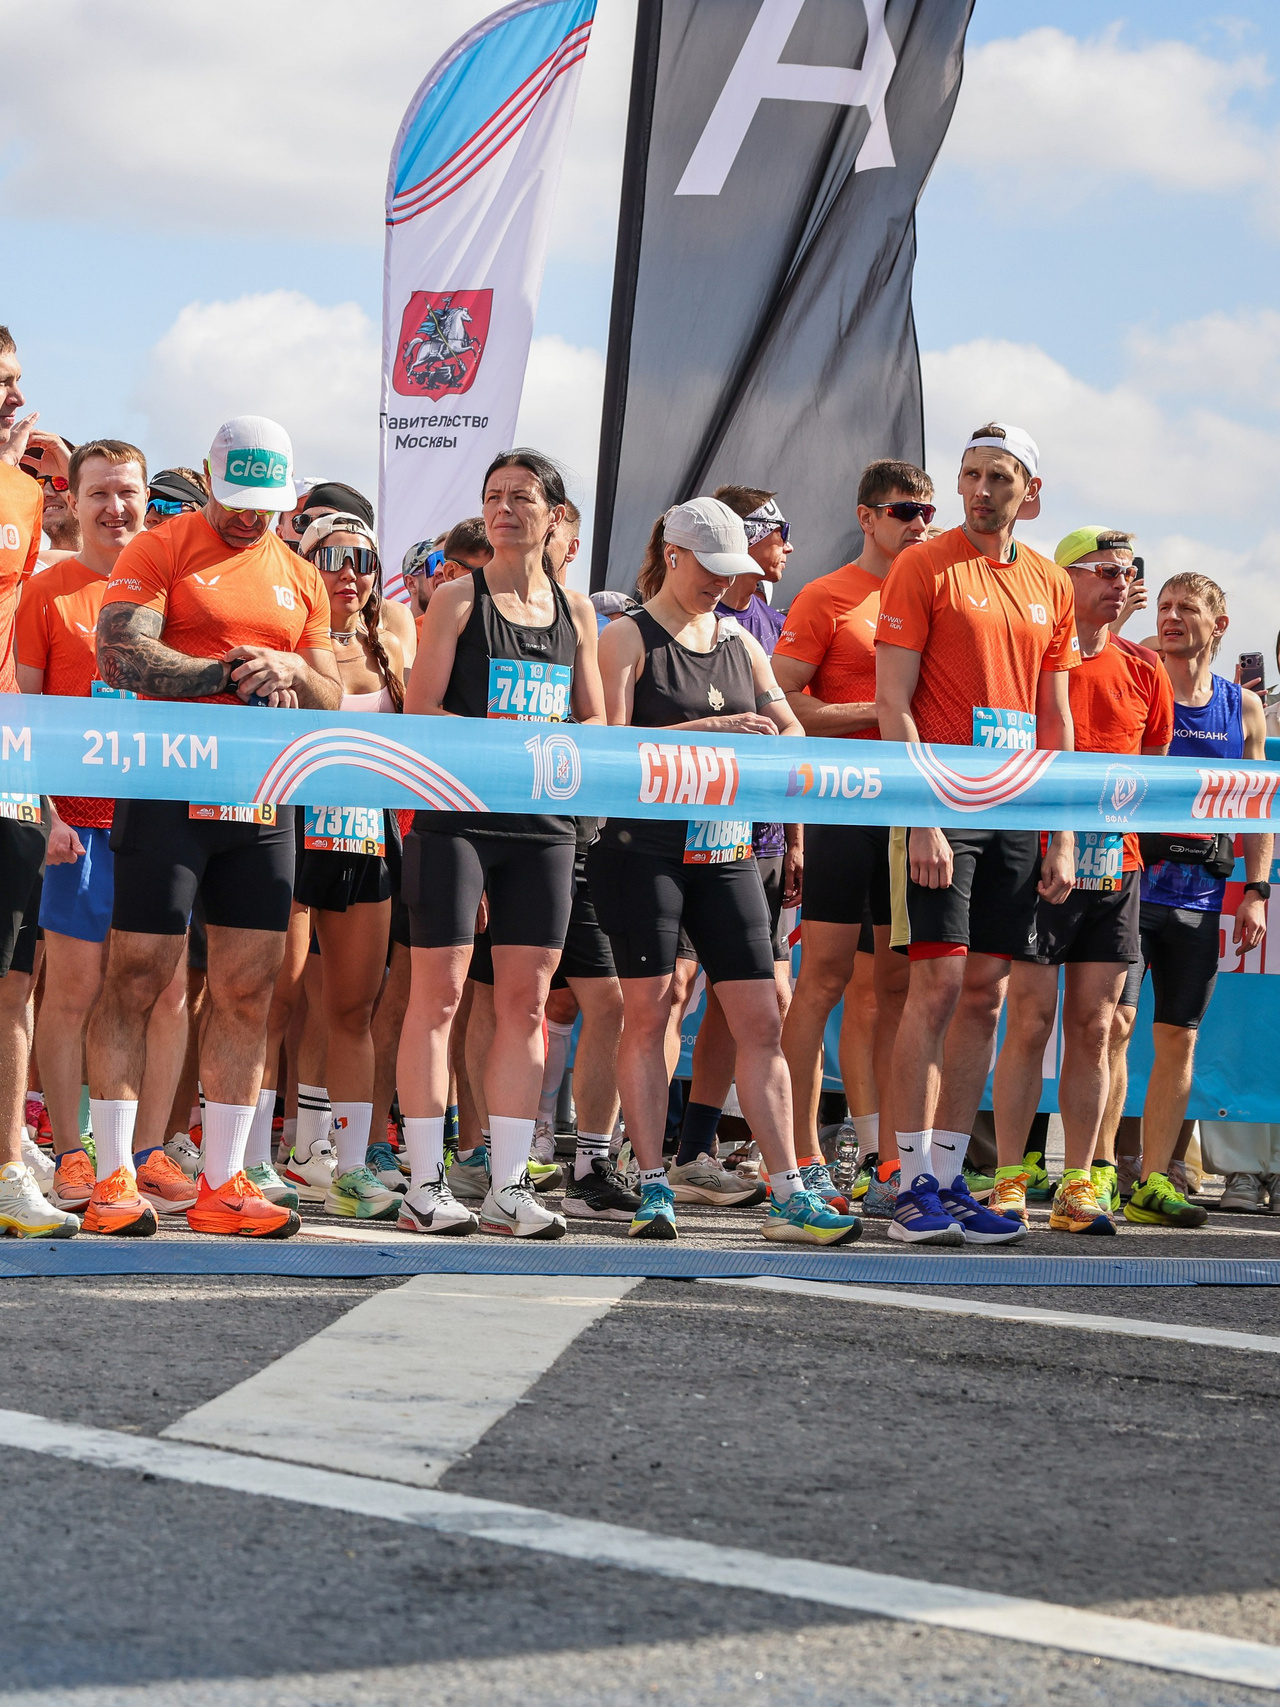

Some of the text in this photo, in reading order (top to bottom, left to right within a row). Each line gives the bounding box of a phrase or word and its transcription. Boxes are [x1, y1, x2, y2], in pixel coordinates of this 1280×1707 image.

[380, 412, 489, 430] авительство
[395, 434, 457, 450] Москвы
[230, 455, 284, 480] ciele
[497, 677, 566, 717] 74768
[1173, 728, 1228, 741] КОМБАНК
[82, 729, 146, 774] 21,1
[162, 732, 218, 770] КМ
[523, 733, 582, 800] 10
[639, 742, 737, 805] СТАРТ
[818, 765, 883, 799] ПСБ
[1191, 769, 1280, 819] СТАРТ
[312, 805, 379, 840] 73753
[1105, 814, 1129, 823] ВФЛА
[694, 820, 750, 848] 70864
[1074, 847, 1119, 877] 450
[1074, 877, 1100, 890] 1.1КМ
